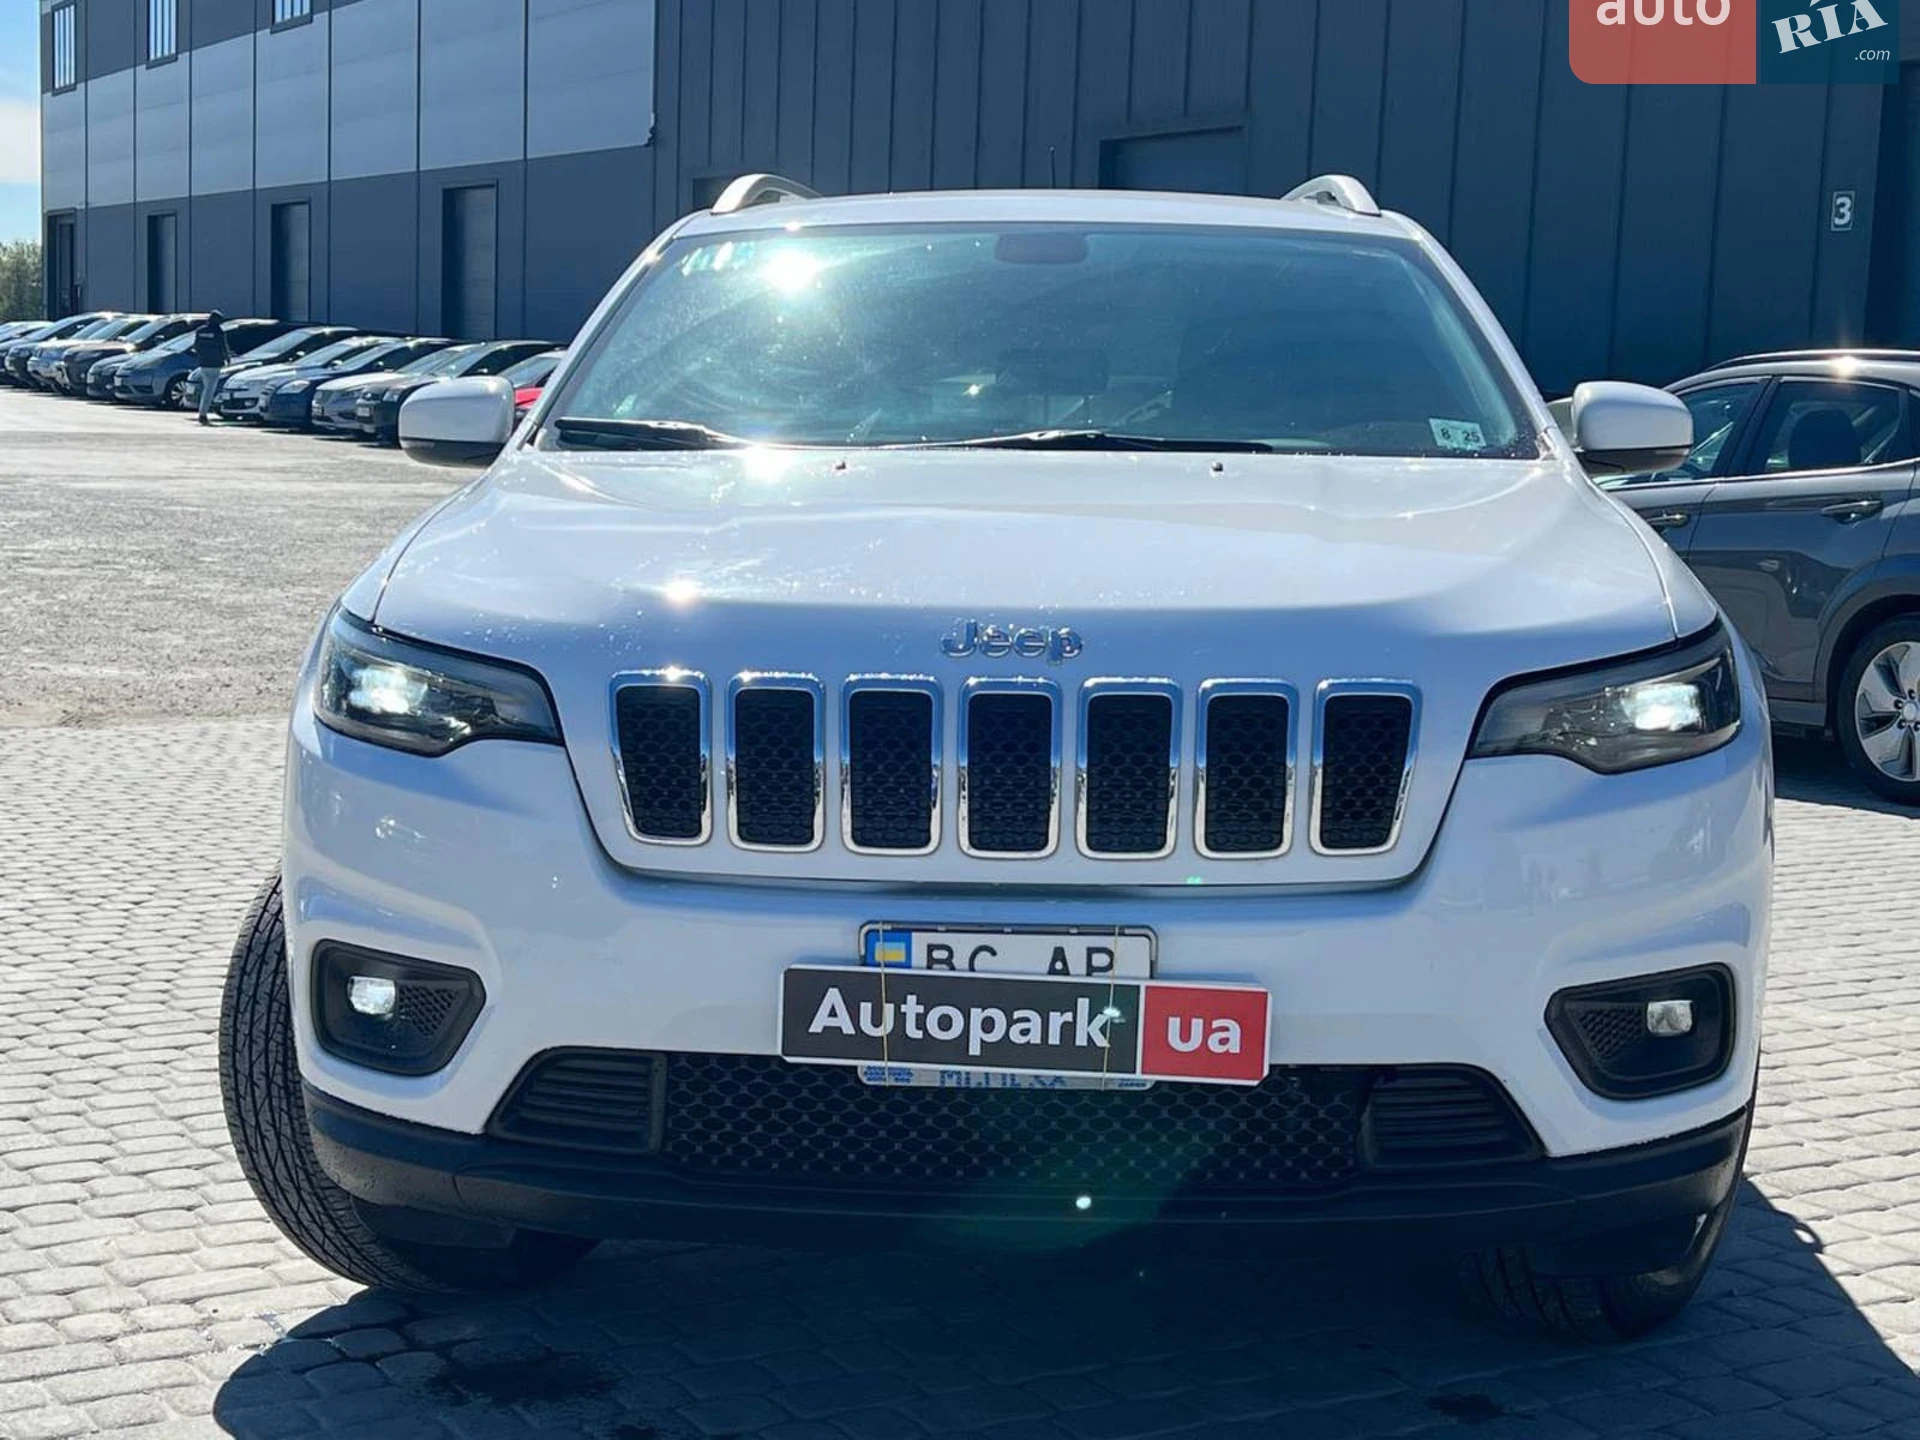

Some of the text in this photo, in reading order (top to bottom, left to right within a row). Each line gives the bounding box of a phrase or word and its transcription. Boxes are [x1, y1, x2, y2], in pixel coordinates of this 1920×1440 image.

[1834, 196, 1852, 225] 3
[940, 620, 1084, 664] Jeep
[808, 987, 1242, 1056] Autopark ua
